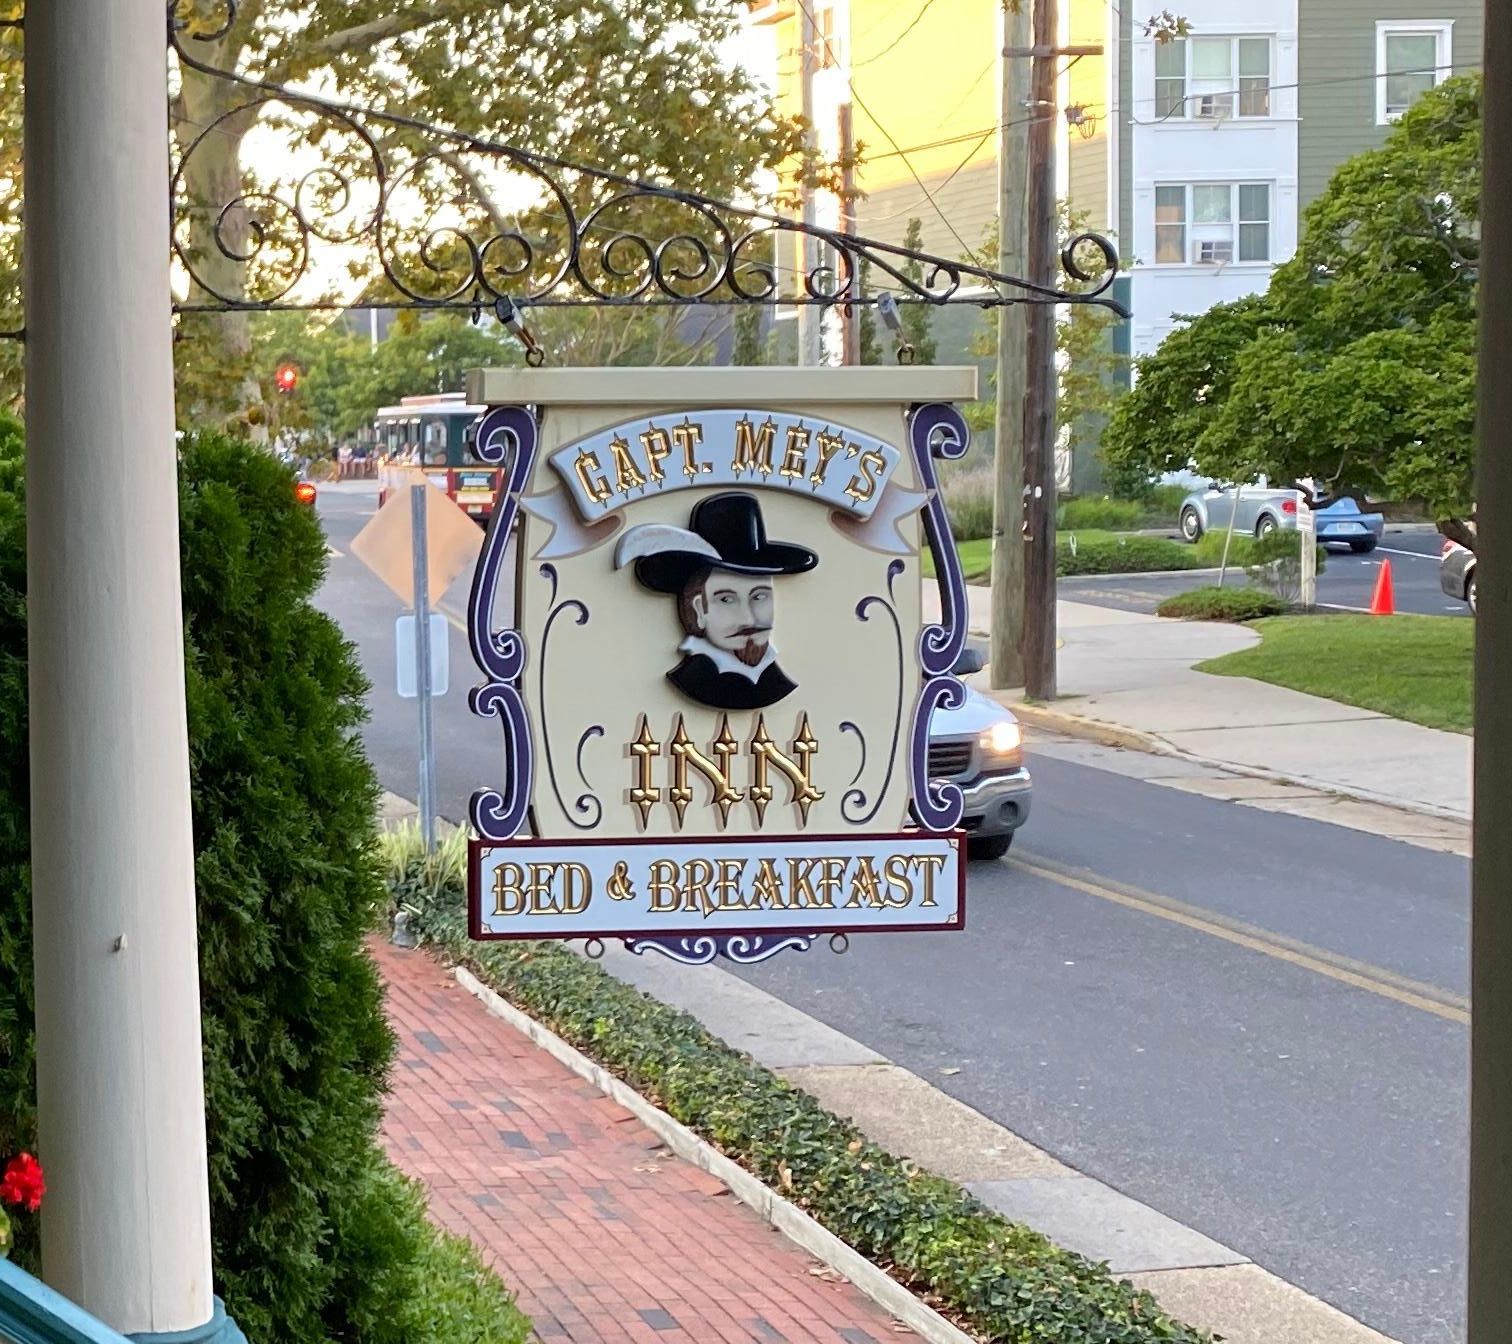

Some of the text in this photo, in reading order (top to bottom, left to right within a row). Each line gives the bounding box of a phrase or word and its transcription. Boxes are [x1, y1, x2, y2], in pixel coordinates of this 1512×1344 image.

[574, 412, 887, 507] CAPT. MEY'S
[629, 712, 826, 831] INN
[491, 854, 947, 920] BED & BREAKFAST
